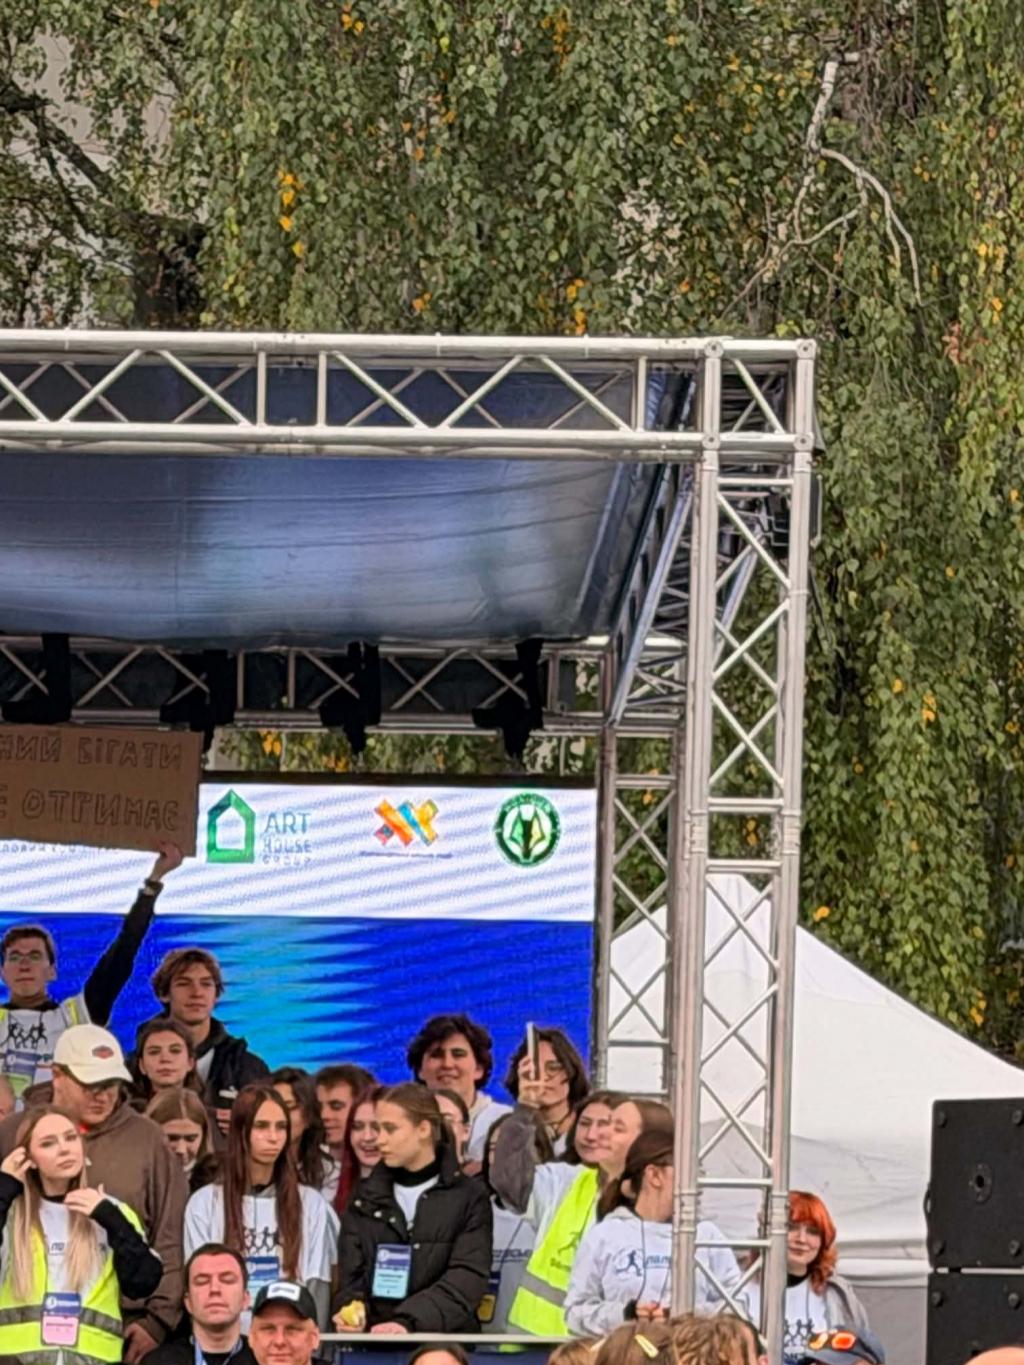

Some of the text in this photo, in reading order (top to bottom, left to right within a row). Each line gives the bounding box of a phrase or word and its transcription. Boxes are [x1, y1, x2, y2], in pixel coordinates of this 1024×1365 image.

[77, 736, 182, 770] БІГАТИ
[22, 788, 179, 832] ОТРИМАЄ
[264, 811, 311, 835] ART
